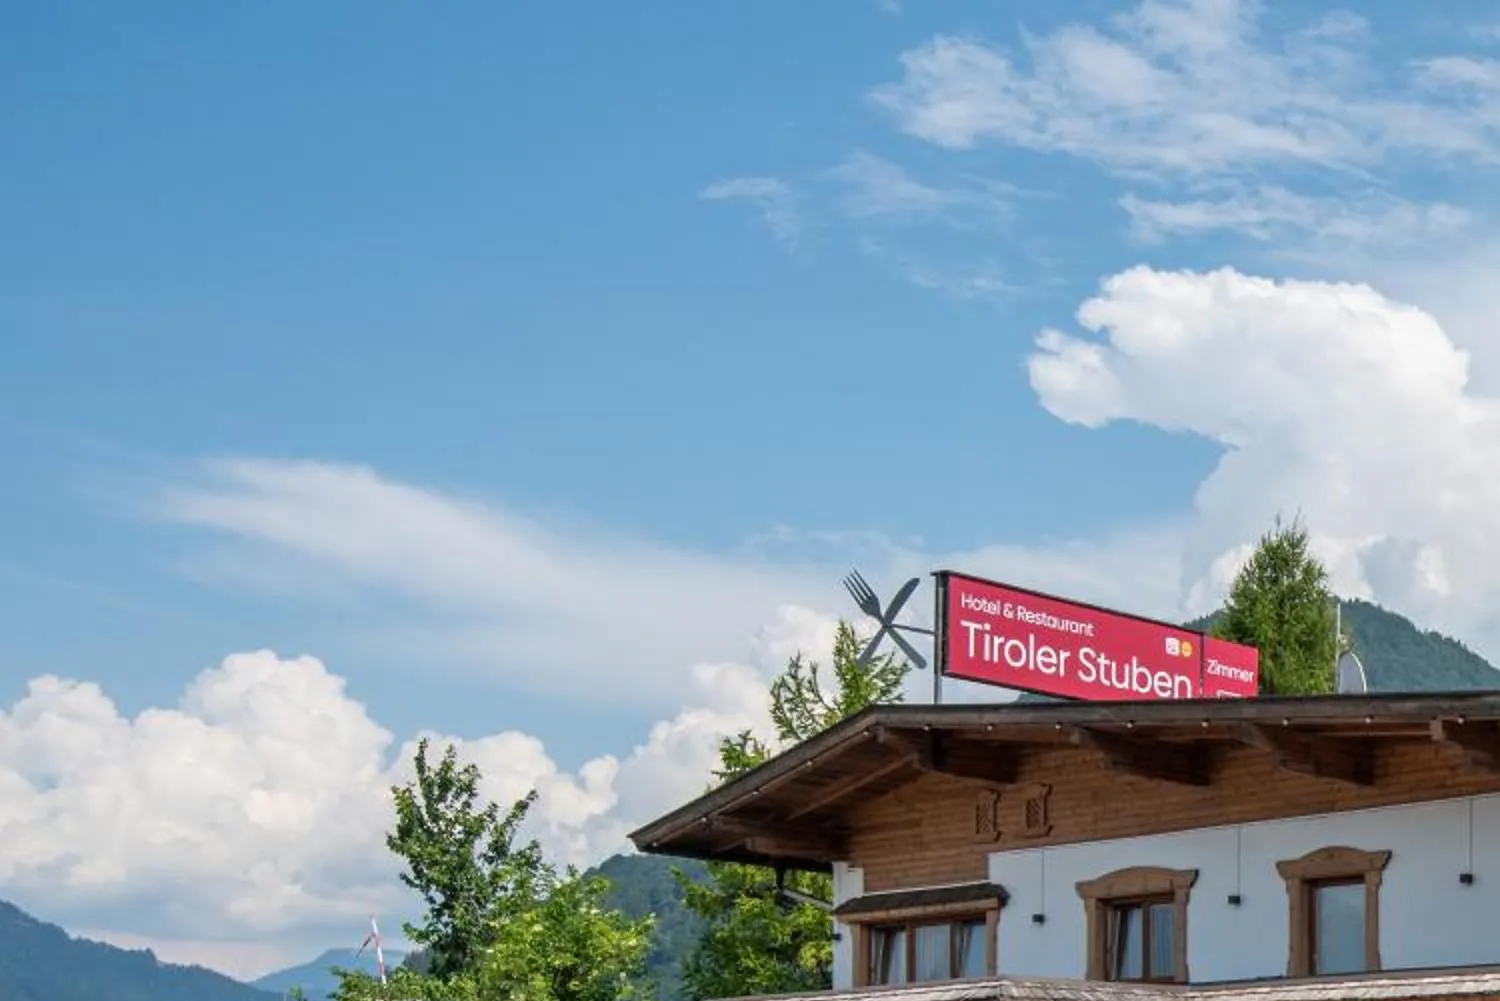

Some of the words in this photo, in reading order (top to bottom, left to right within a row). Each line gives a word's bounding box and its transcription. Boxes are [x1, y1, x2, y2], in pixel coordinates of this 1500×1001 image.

[961, 592, 1000, 615] Hotel
[1003, 604, 1014, 619] &
[1017, 605, 1095, 637] Restaurant
[960, 620, 1070, 678] Tiroler
[1078, 646, 1193, 698] Stuben
[1207, 659, 1254, 683] Zimmer
